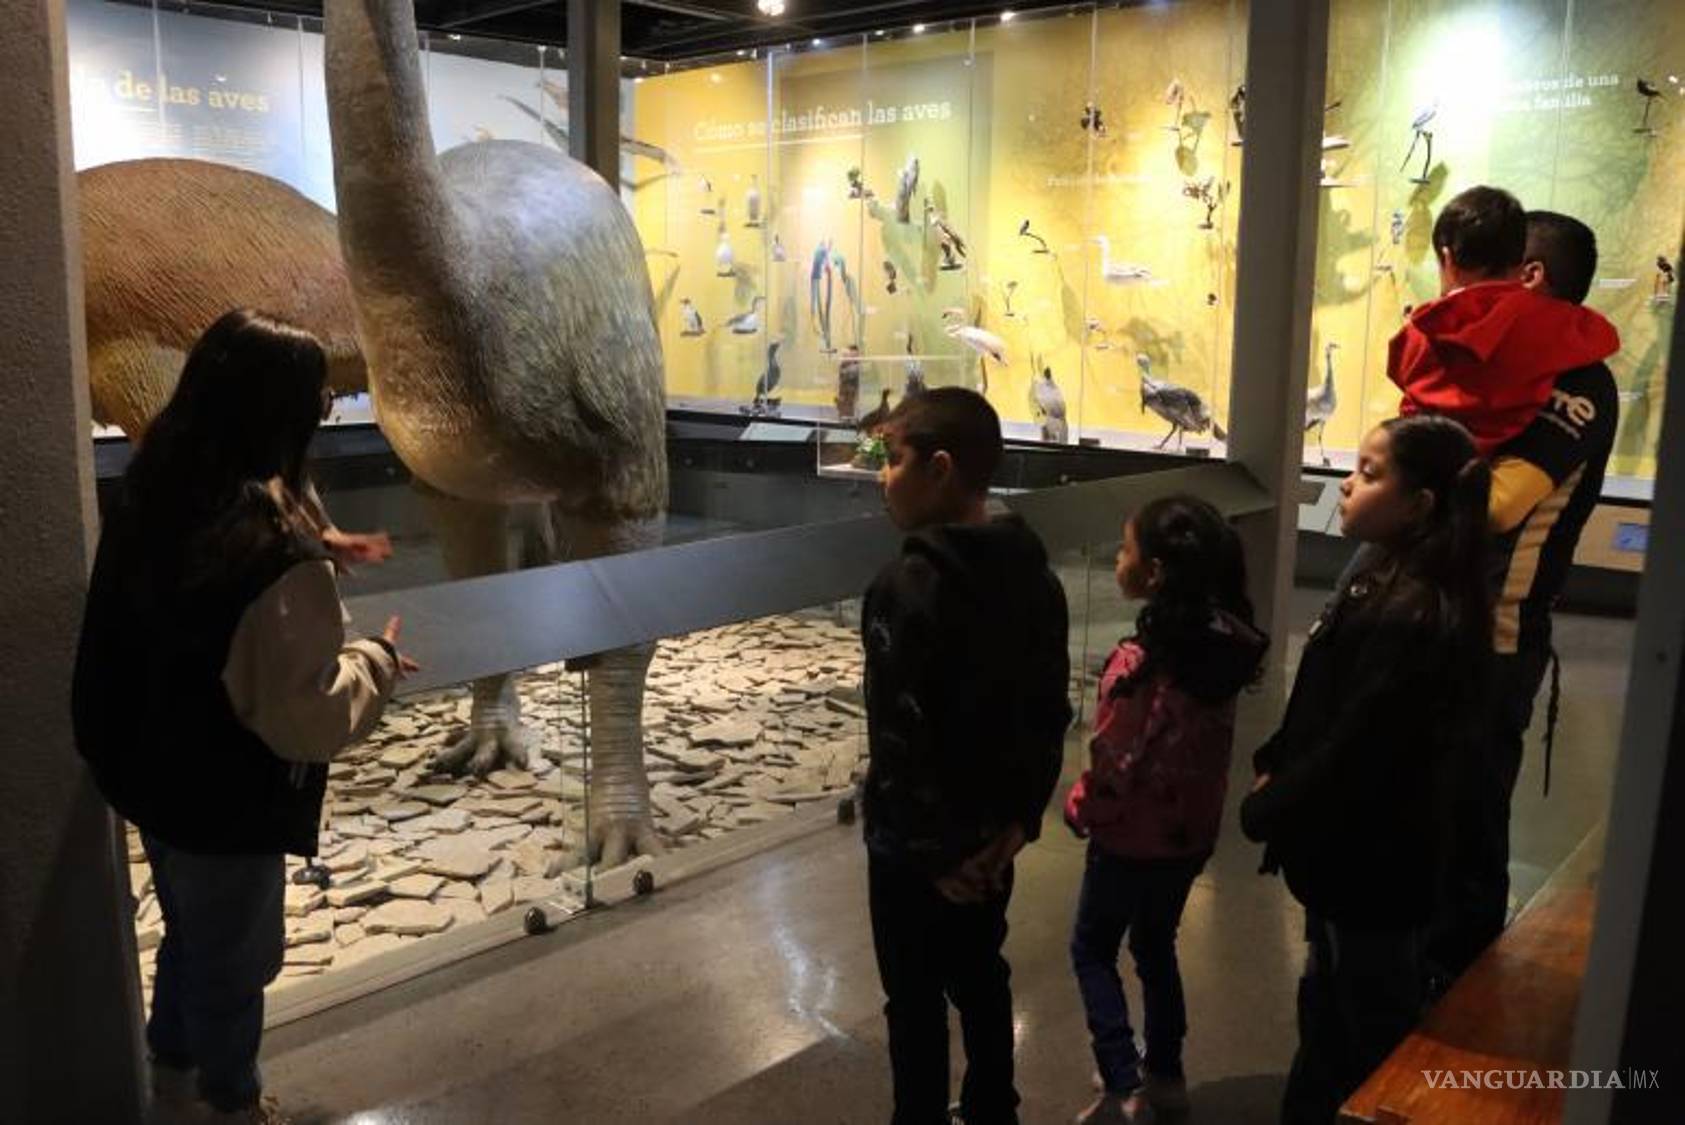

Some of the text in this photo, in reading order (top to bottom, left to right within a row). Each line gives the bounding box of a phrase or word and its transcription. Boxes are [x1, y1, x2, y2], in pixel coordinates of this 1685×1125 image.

[115, 68, 151, 101] de
[158, 72, 200, 105] las
[207, 85, 269, 113] aves
[1587, 73, 1619, 87] una
[772, 105, 862, 134] clasifican
[866, 99, 897, 125] las
[902, 100, 951, 121] aves
